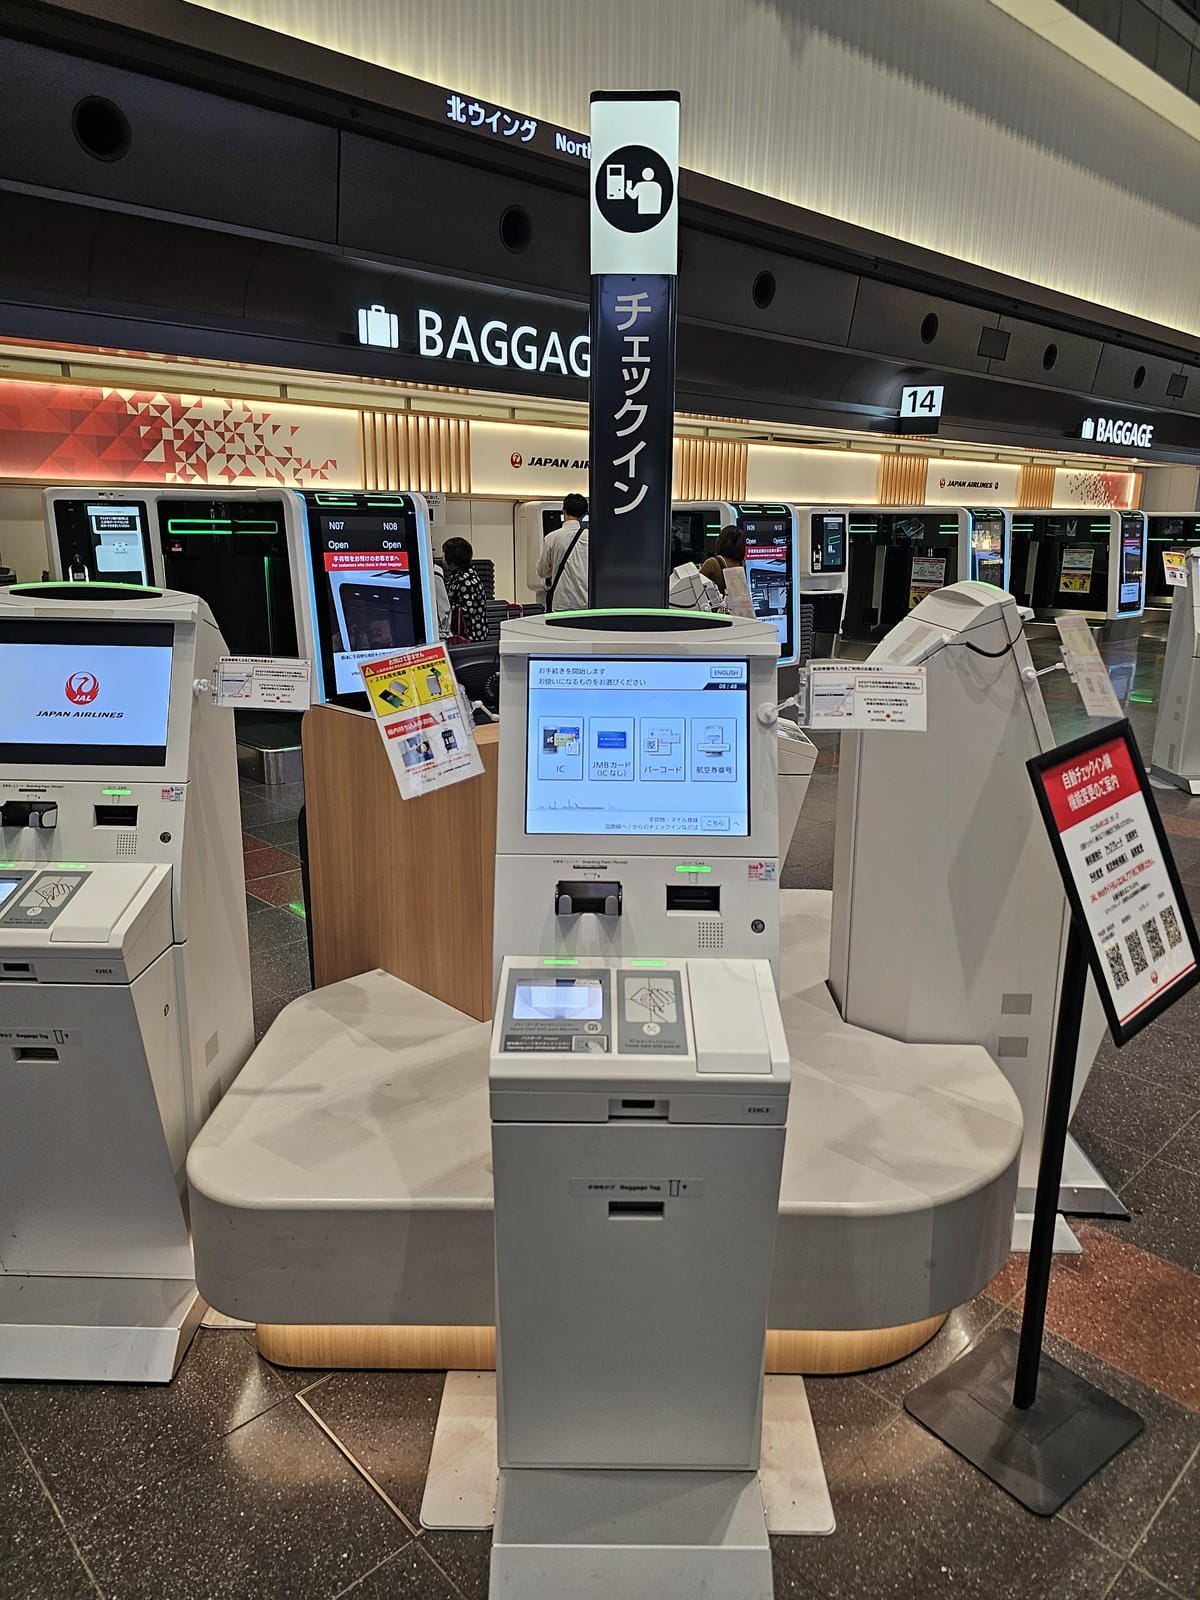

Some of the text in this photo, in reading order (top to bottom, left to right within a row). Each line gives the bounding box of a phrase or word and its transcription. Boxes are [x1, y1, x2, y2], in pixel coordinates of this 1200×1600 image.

[446, 95, 538, 142] 北ウイング
[418, 309, 590, 378] BAGGAG
[613, 291, 652, 515] チェックイン
[907, 390, 936, 413] 14
[1096, 418, 1154, 448] BAGGAGE
[527, 457, 569, 467] JAPAN
[967, 481, 993, 489] AIRLINES
[328, 521, 345, 531] N07
[383, 522, 398, 531] N08
[328, 540, 349, 550] Open
[382, 540, 402, 550] Open
[538, 667, 606, 675] お手続きを開始します
[556, 765, 565, 773] IC
[644, 766, 682, 774] バーコード
[706, 819, 725, 827] こちら
